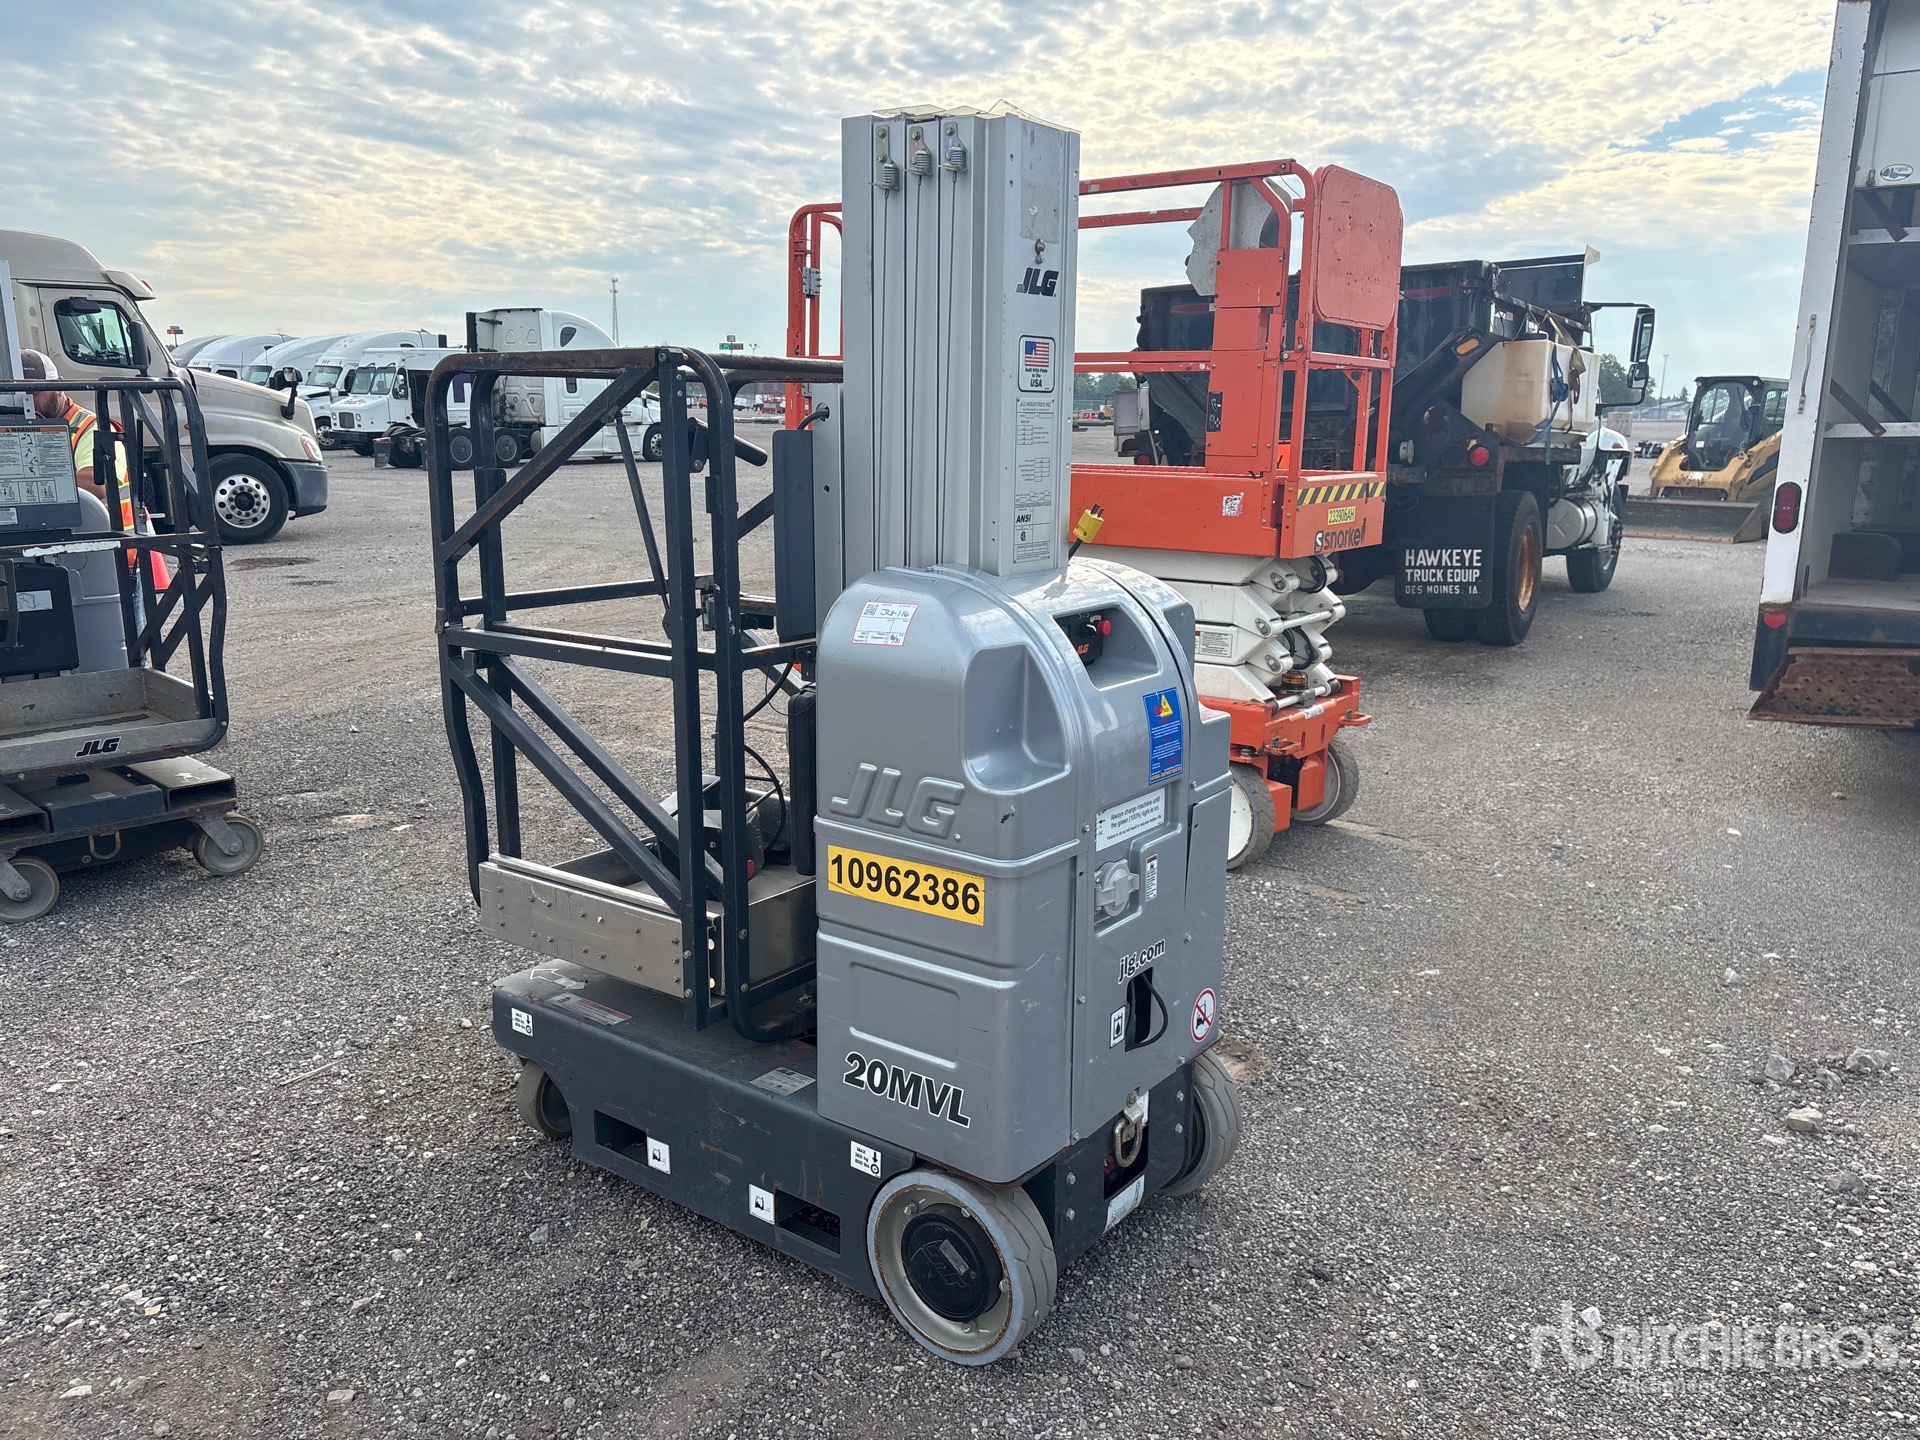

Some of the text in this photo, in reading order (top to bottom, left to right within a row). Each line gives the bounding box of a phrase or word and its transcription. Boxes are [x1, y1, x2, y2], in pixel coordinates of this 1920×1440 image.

[1016, 267, 1059, 297] JLG
[1030, 378, 1042, 388] USA
[1015, 514, 1032, 524] ANSI
[1323, 517, 1367, 551] snorkel
[1405, 548, 1482, 567] HAWKEYE
[1405, 568, 1482, 583] TRUCK EQUIP.
[1405, 585, 1423, 595] DES
[75, 736, 122, 758] JLG
[829, 762, 965, 840] JLG
[831, 854, 981, 916] 10962386
[1118, 939, 1165, 984] jlg.com
[843, 1051, 971, 1129] 20MVL
